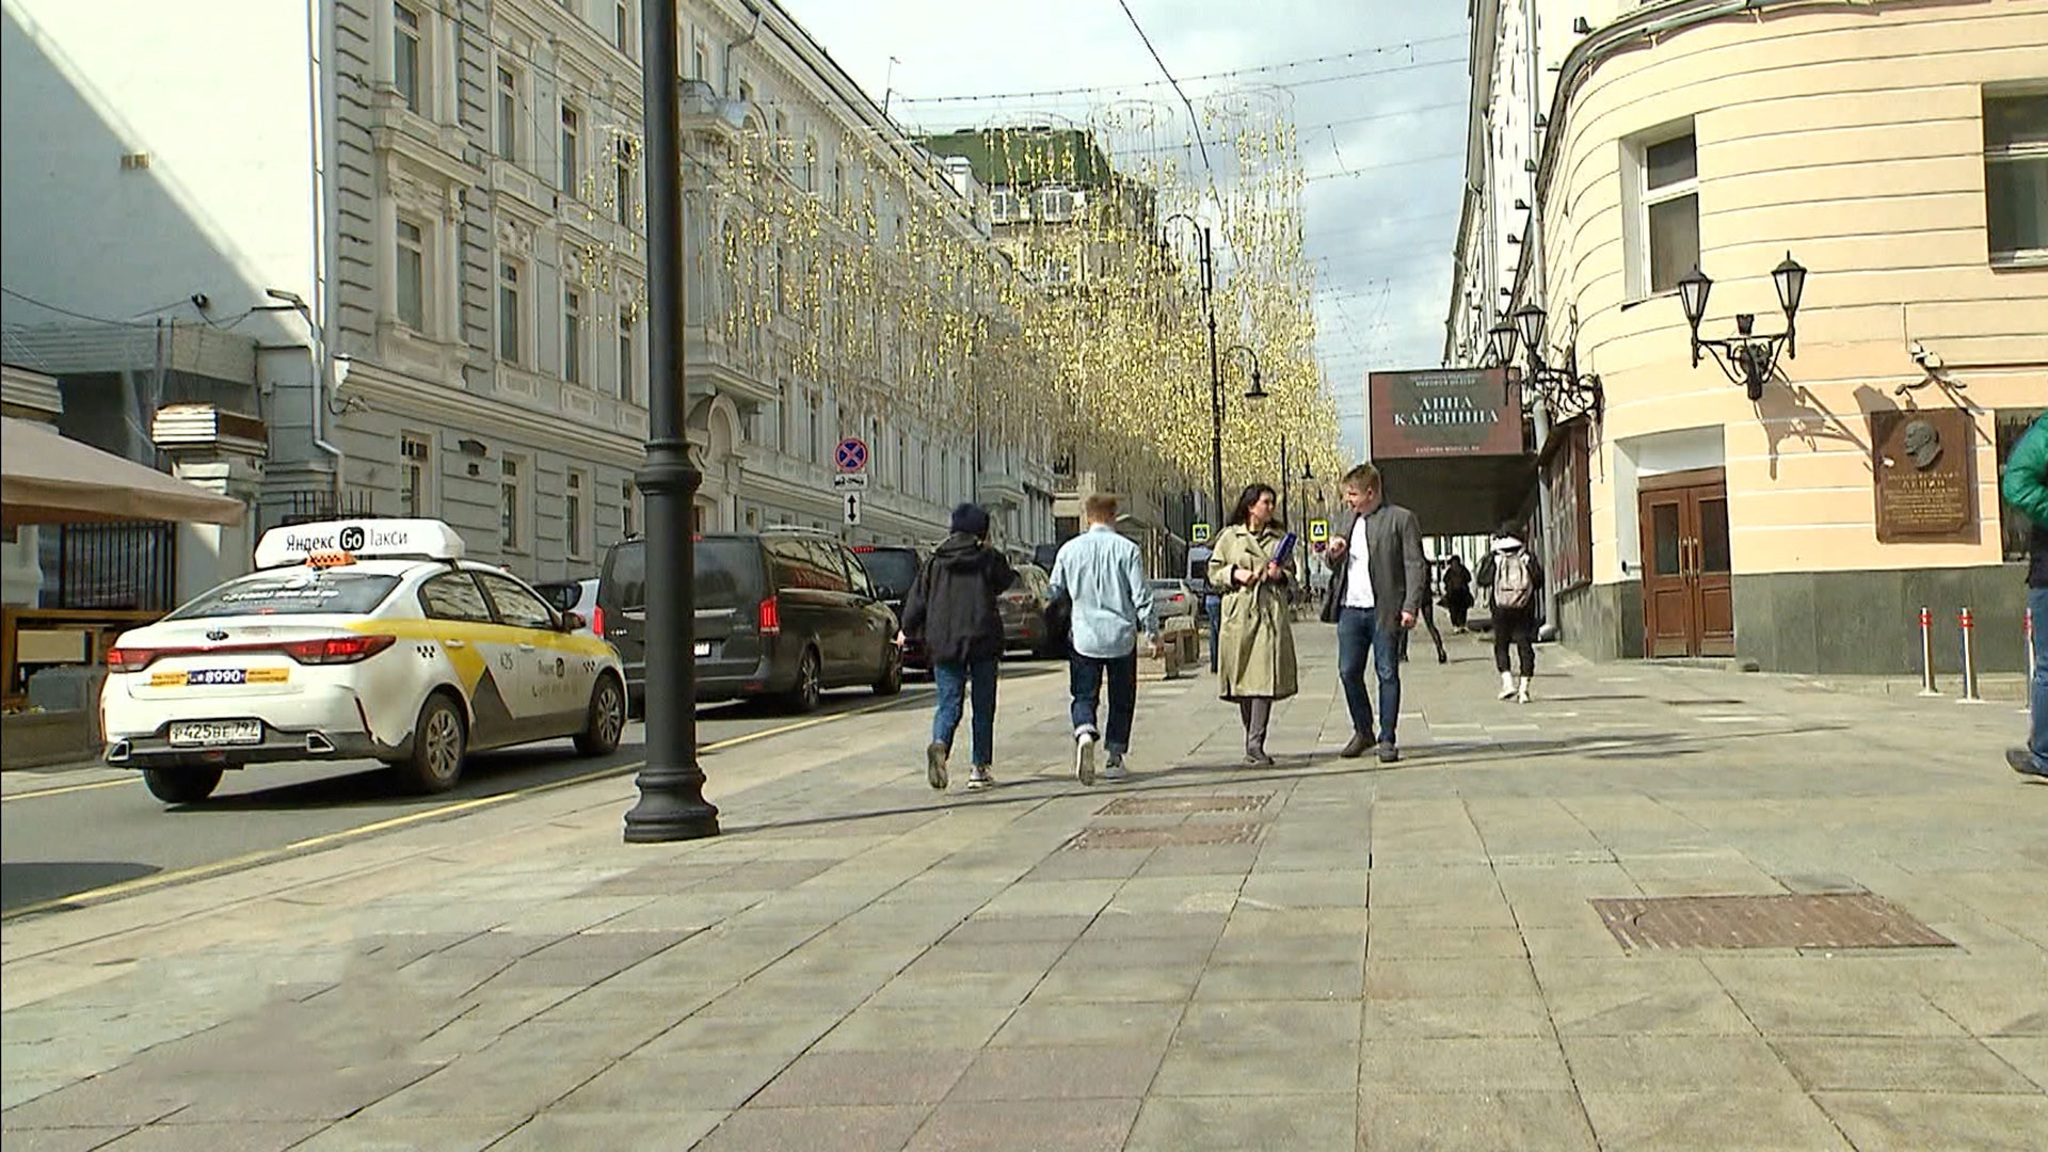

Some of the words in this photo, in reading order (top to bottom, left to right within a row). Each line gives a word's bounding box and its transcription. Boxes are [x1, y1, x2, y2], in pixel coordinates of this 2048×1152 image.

[1420, 396, 1473, 411] АННА
[1393, 409, 1499, 426] КАРЕНИНА
[286, 533, 334, 552] Яндекс
[341, 528, 363, 549] Go
